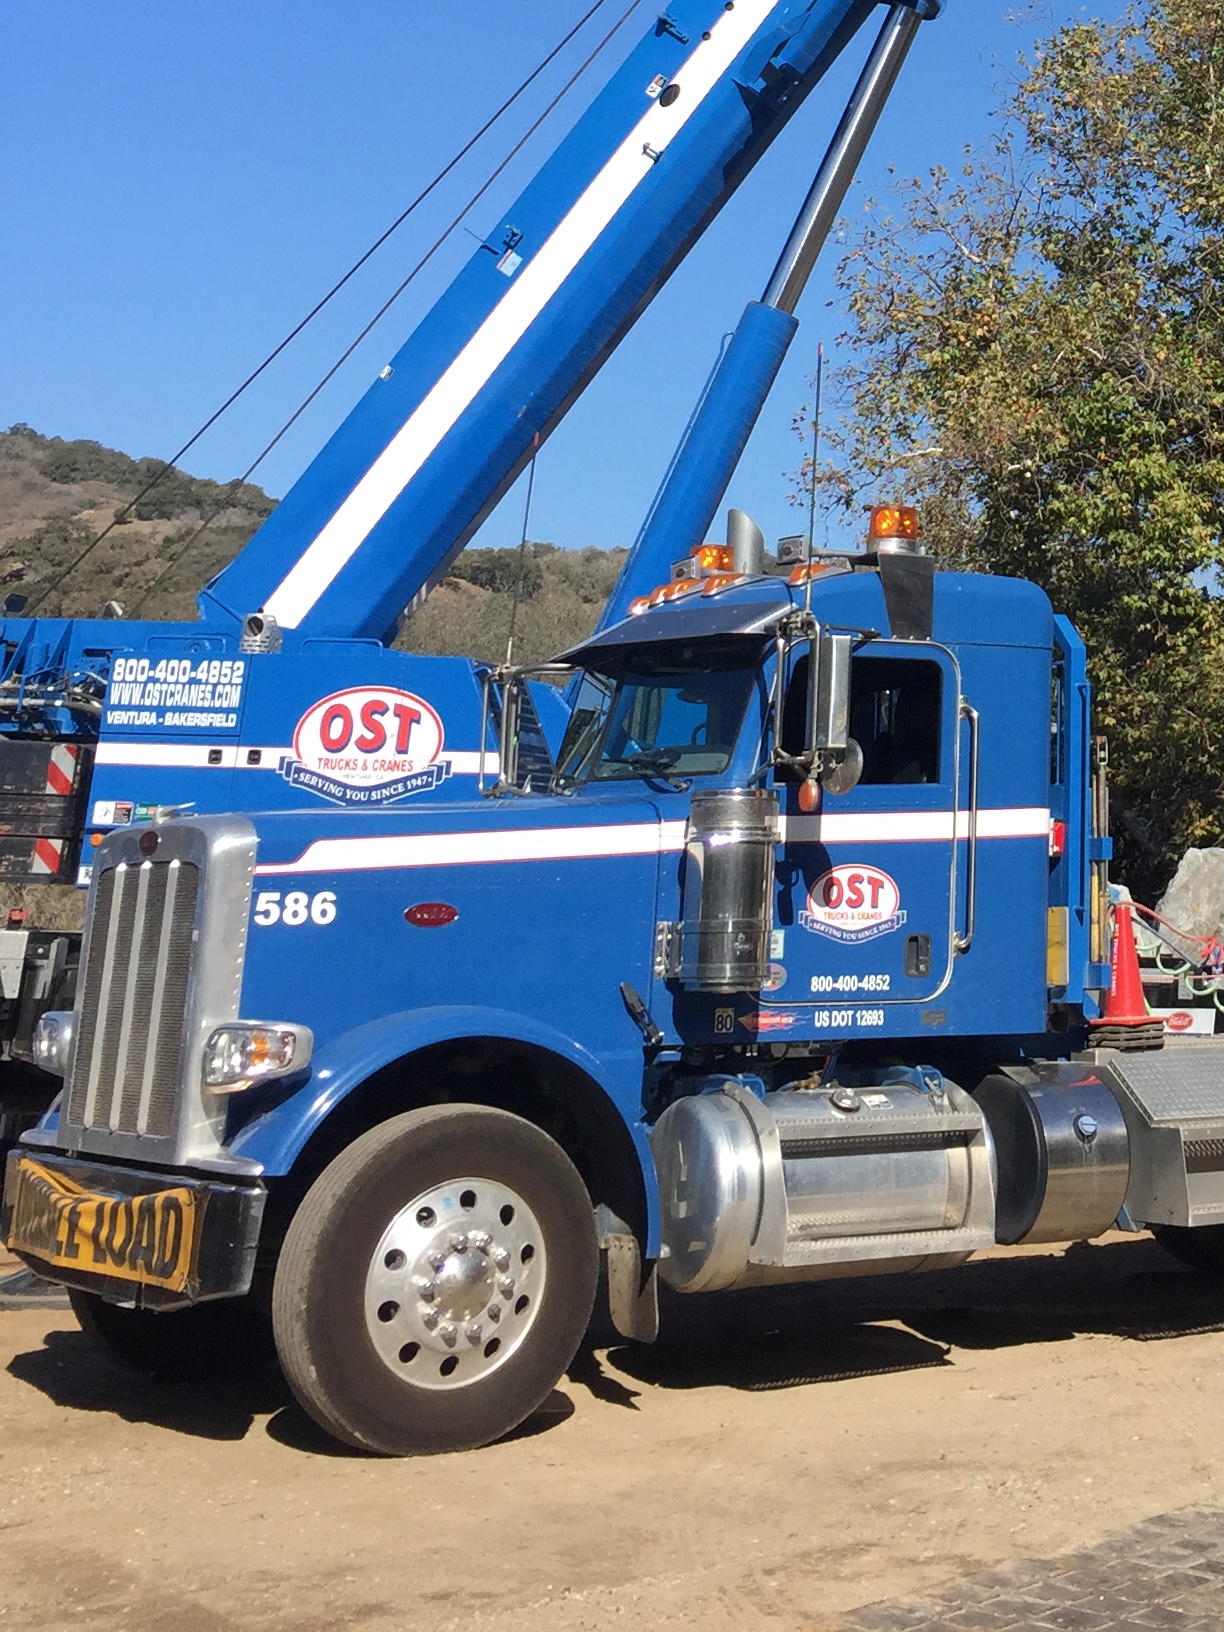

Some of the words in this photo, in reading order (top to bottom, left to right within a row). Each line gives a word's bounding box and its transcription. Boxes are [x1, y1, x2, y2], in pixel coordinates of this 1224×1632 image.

[112, 658, 245, 684] 800-400-4852
[109, 683, 242, 708] WWW.OSTCRANES.COM
[106, 711, 157, 726] VENTURA
[164, 711, 237, 728] BAKERSFIELD
[319, 699, 422, 755] OST
[317, 757, 359, 772] TRUCKS
[361, 758, 369, 772] &
[372, 759, 414, 773] CRANES
[298, 772, 344, 797] SERVING
[345, 790, 369, 802] YOU
[370, 783, 405, 801] SINCE
[406, 775, 428, 791] 1947
[823, 873, 885, 909] OST
[253, 891, 337, 926] 586
[811, 974, 890, 992] 800-400-4852
[715, 1014, 733, 1032] 80
[814, 1011, 830, 1027] US
[831, 1010, 853, 1027] DOT
[856, 1009, 884, 1026] 12693
[92, 1196, 183, 1279] LOAD
